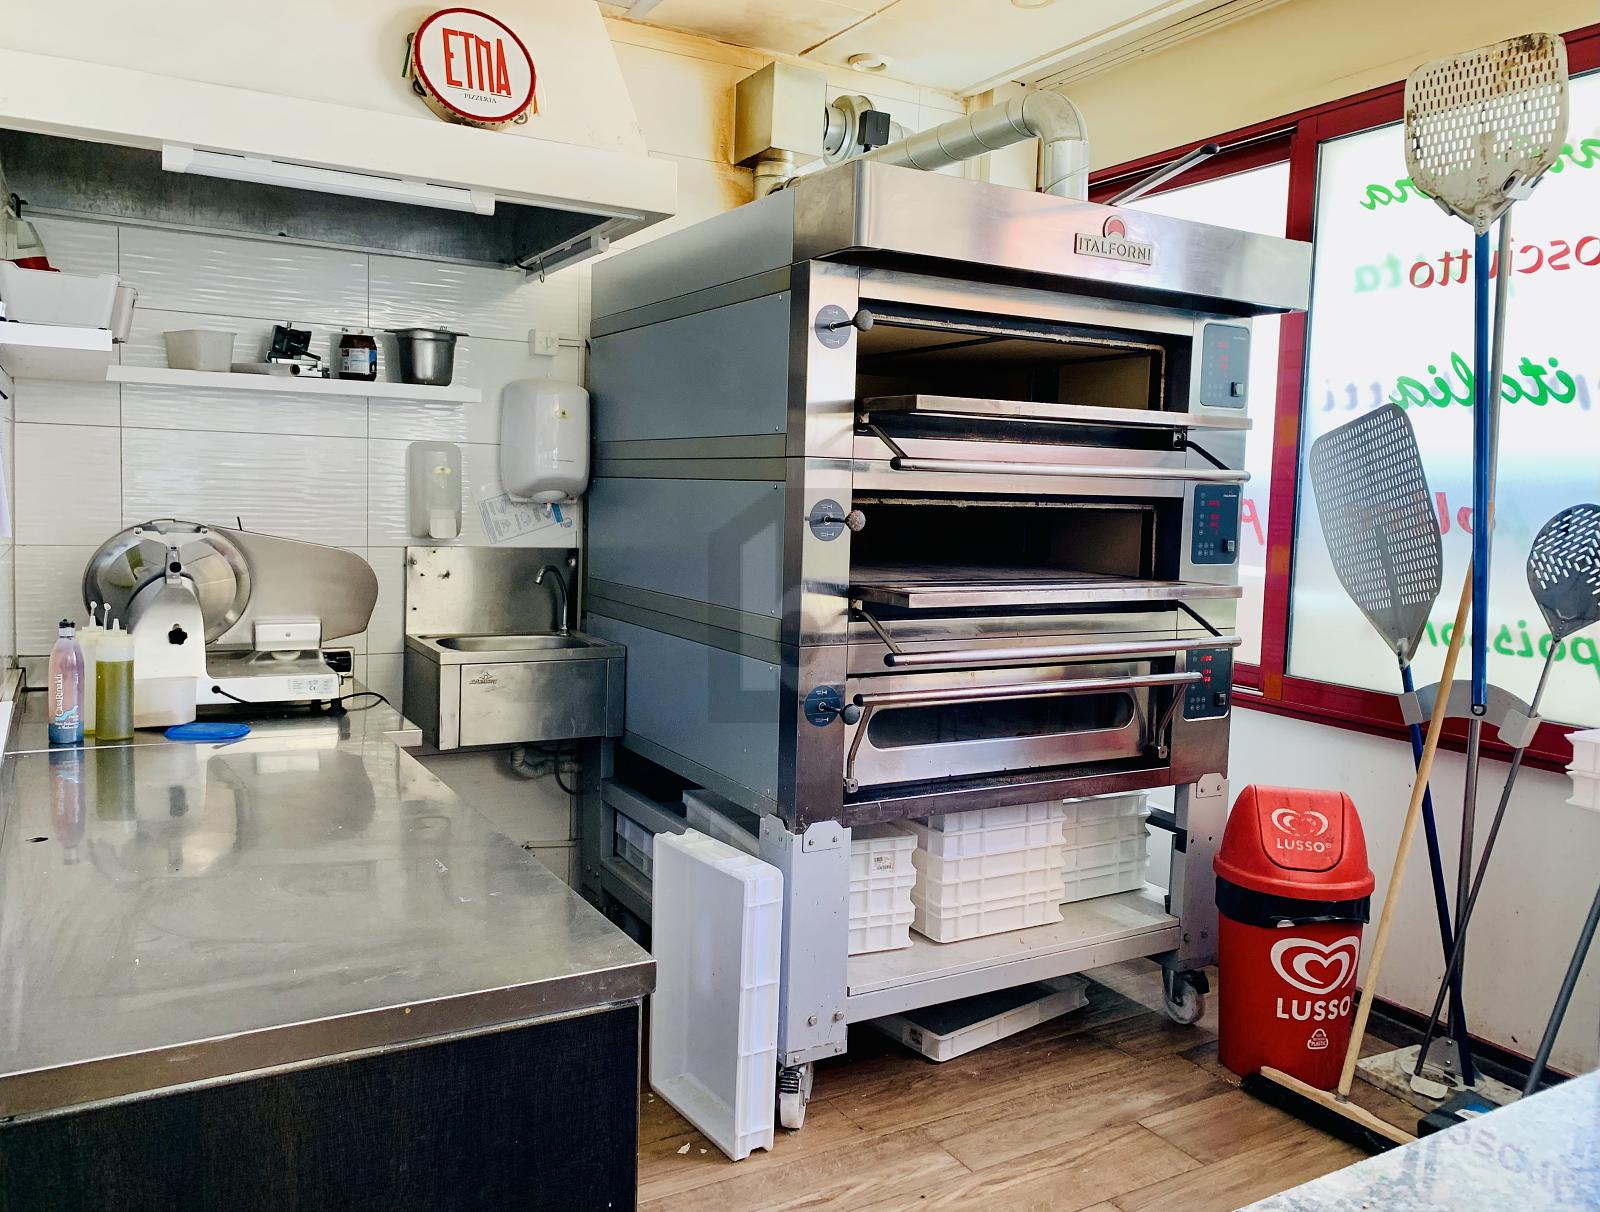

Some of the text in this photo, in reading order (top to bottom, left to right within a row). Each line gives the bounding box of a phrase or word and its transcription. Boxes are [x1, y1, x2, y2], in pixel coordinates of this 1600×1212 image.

[442, 28, 511, 96] ETNA
[464, 93, 497, 104] PIZZERIA
[1079, 237, 1151, 261] ITALFORNI
[1276, 995, 1351, 1021] LUSSO
